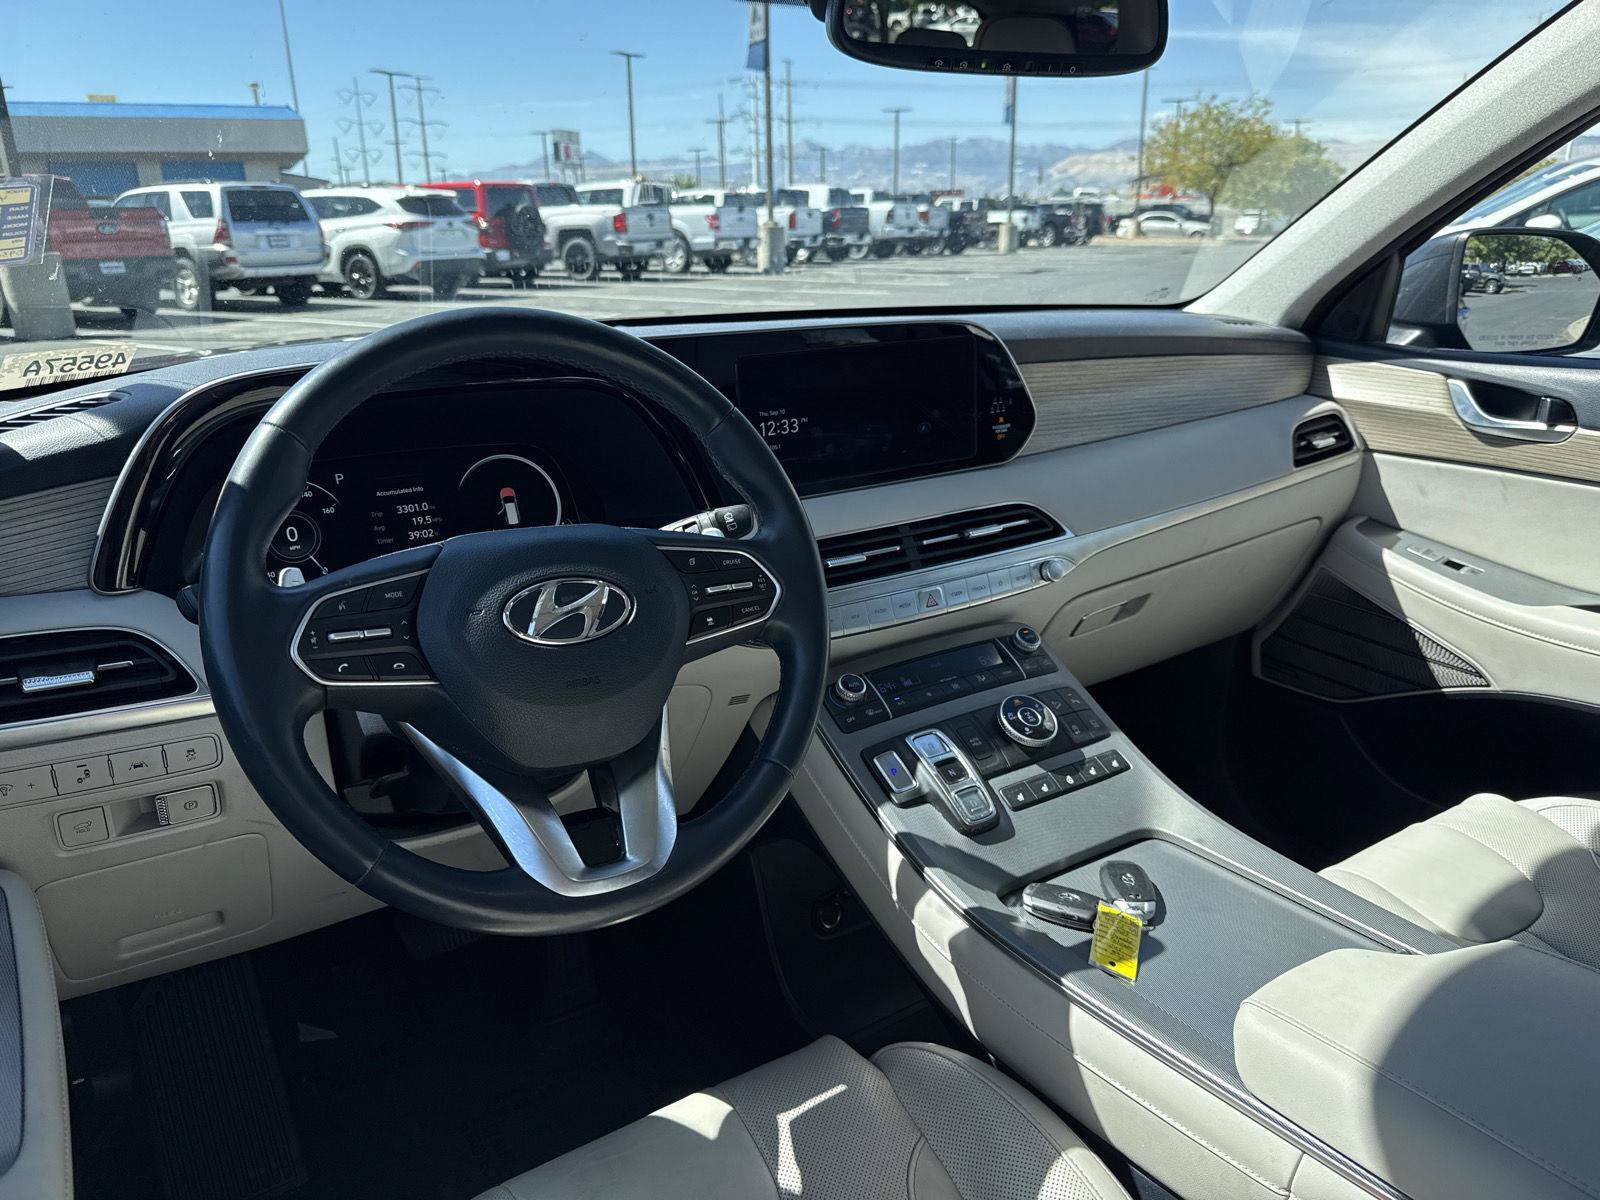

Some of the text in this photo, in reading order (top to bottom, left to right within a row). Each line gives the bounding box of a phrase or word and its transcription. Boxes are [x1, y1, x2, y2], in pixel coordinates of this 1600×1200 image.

[759, 418, 799, 437] 12:33
[334, 473, 344, 485] P
[322, 506, 335, 514] 160
[396, 502, 429, 515] 3301.0
[412, 515, 432, 526] 19.5
[285, 526, 299, 542] 0
[407, 529, 434, 541] 39:02
